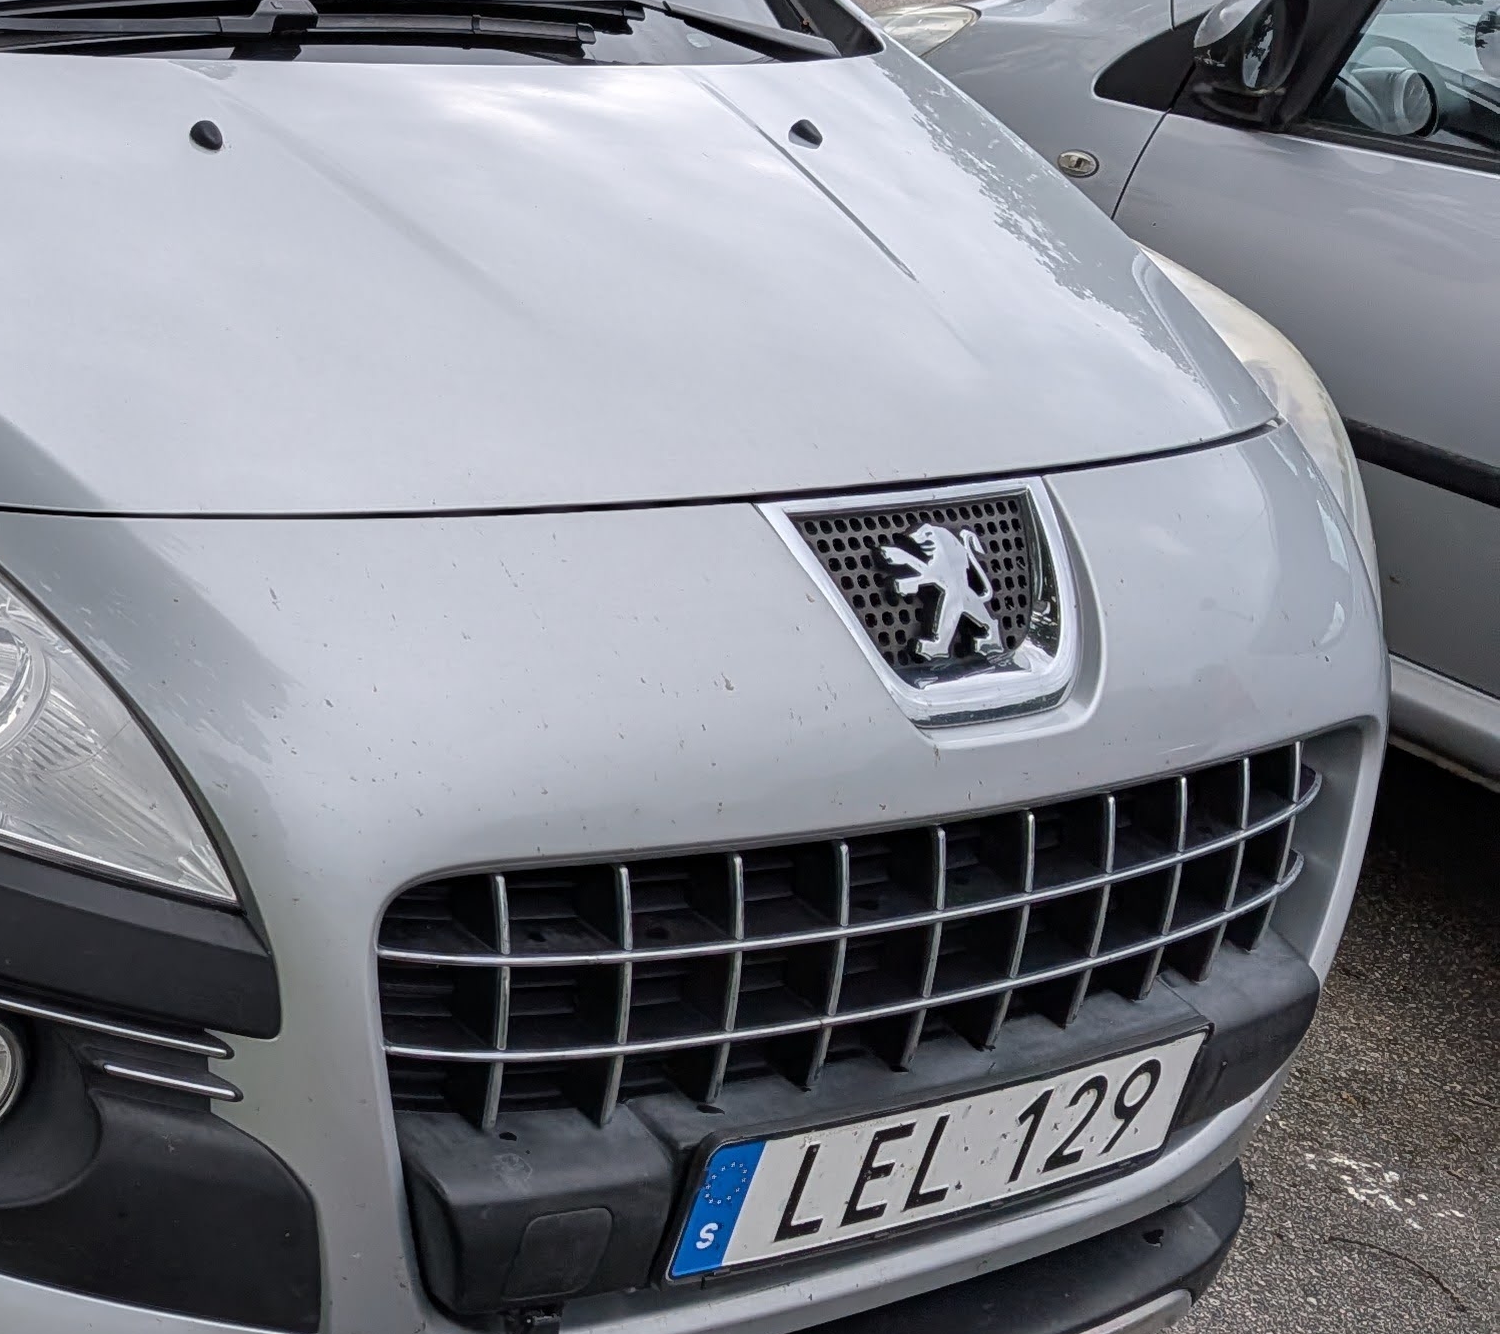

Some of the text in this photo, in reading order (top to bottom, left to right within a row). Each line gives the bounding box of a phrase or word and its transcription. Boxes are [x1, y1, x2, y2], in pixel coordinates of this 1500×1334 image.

[695, 1057, 1162, 1250] S LEL 129
